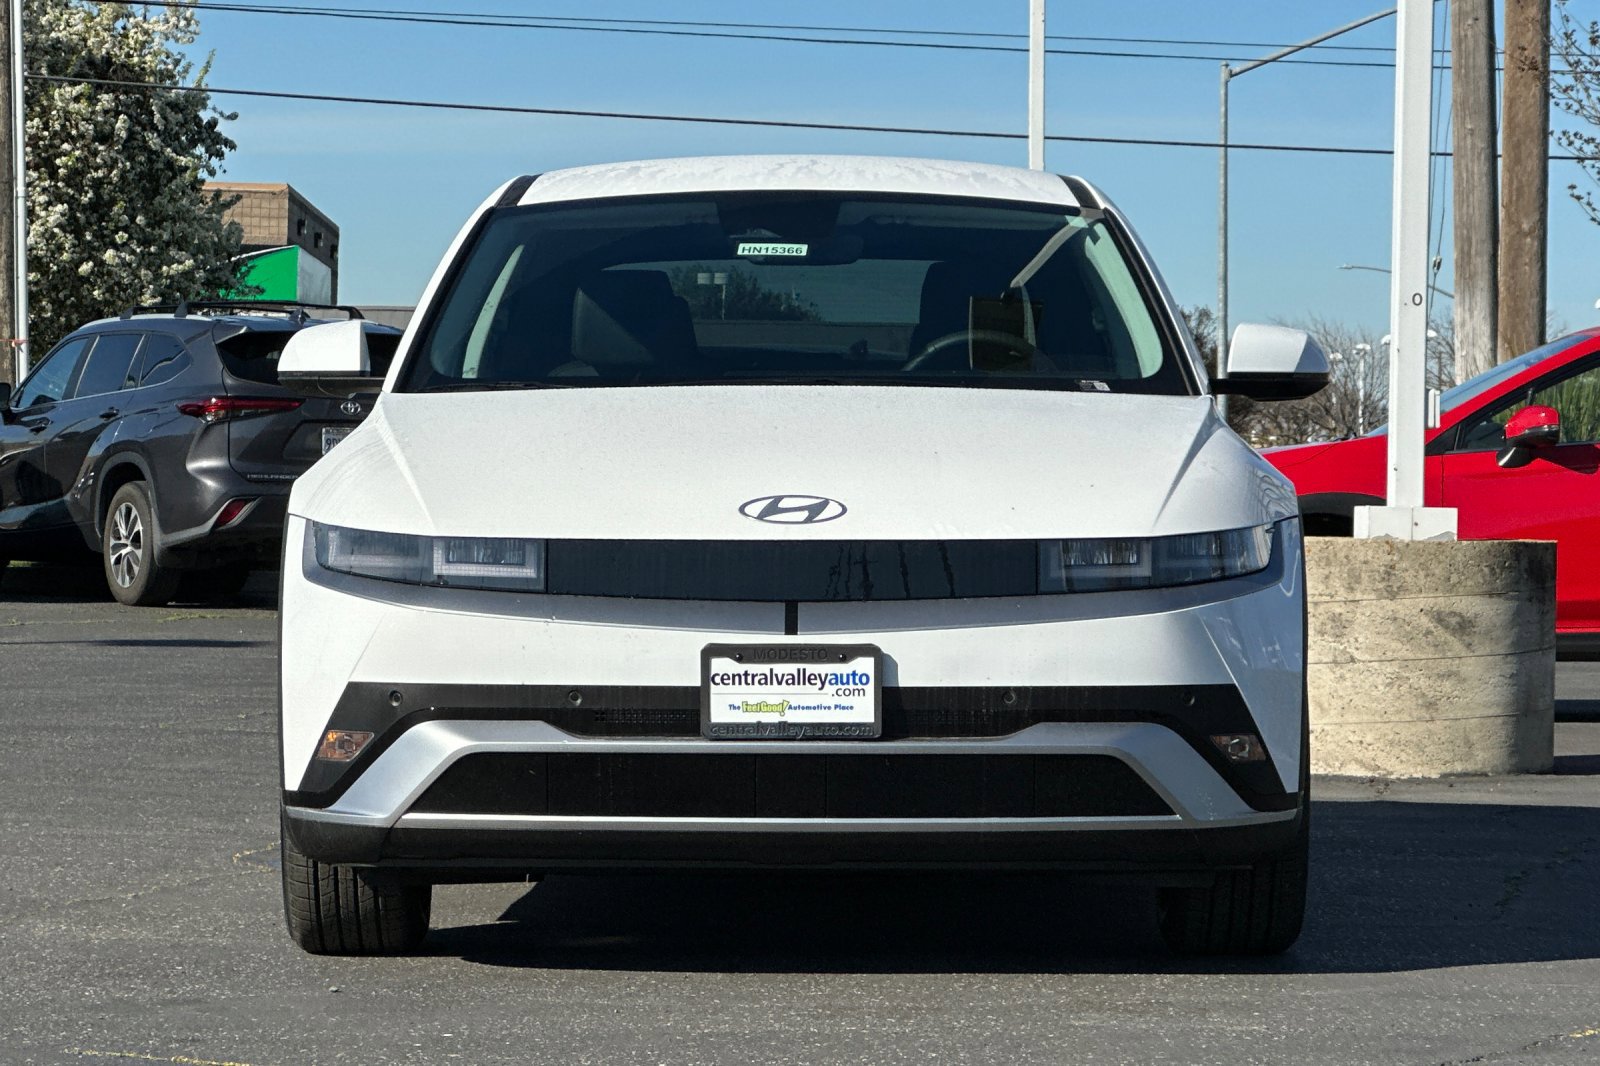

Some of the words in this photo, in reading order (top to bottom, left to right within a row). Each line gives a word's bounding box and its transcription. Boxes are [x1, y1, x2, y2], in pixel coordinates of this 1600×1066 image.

[741, 246, 803, 254] HN15366
[753, 649, 828, 661] MODESTO
[711, 668, 870, 690] centralvalleyauto
[831, 687, 866, 697] .com
[711, 721, 874, 739] centralvalleyauto.com
